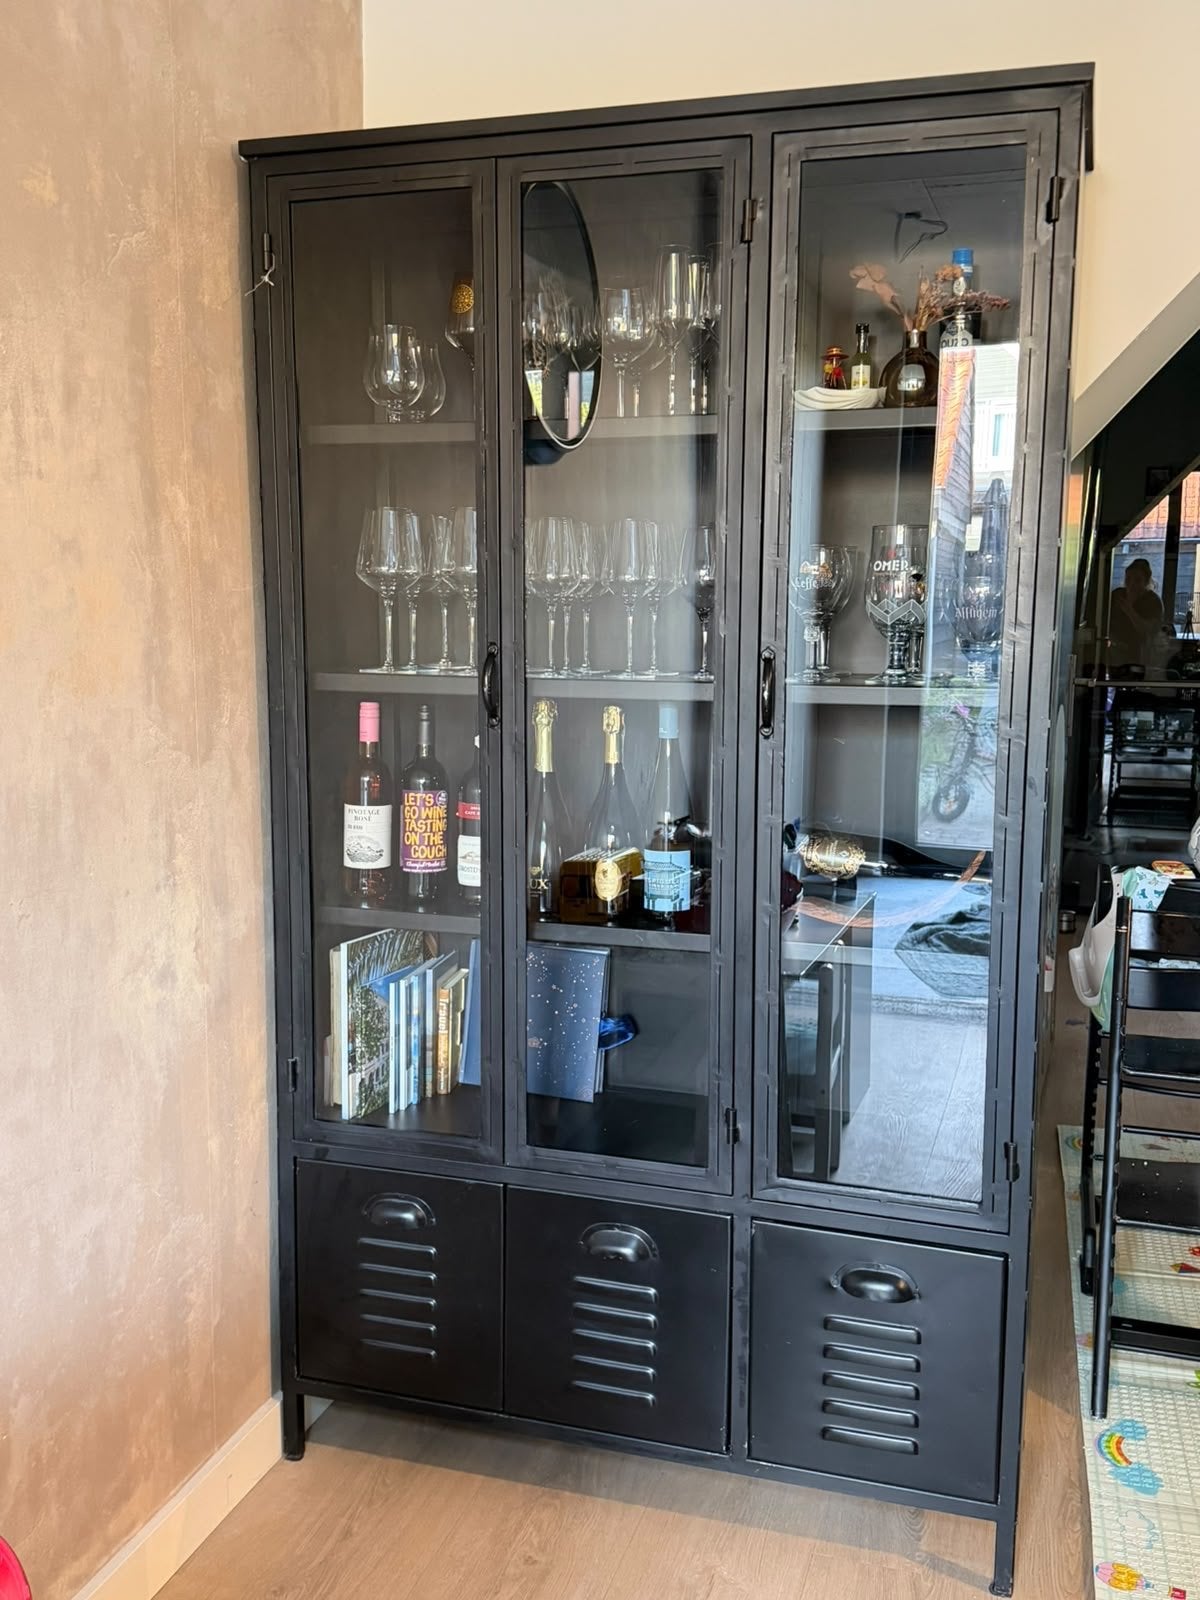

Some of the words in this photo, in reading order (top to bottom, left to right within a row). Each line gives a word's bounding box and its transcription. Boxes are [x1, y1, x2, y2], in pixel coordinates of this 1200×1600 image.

[404, 792, 434, 807] LET'S
[404, 806, 419, 819] GO
[421, 805, 447, 819] WINE
[404, 819, 447, 833] TASTING
[404, 831, 420, 845] ON
[422, 831, 444, 846] THE
[411, 845, 447, 859] COUCH
[528, 878, 549, 890] UX
